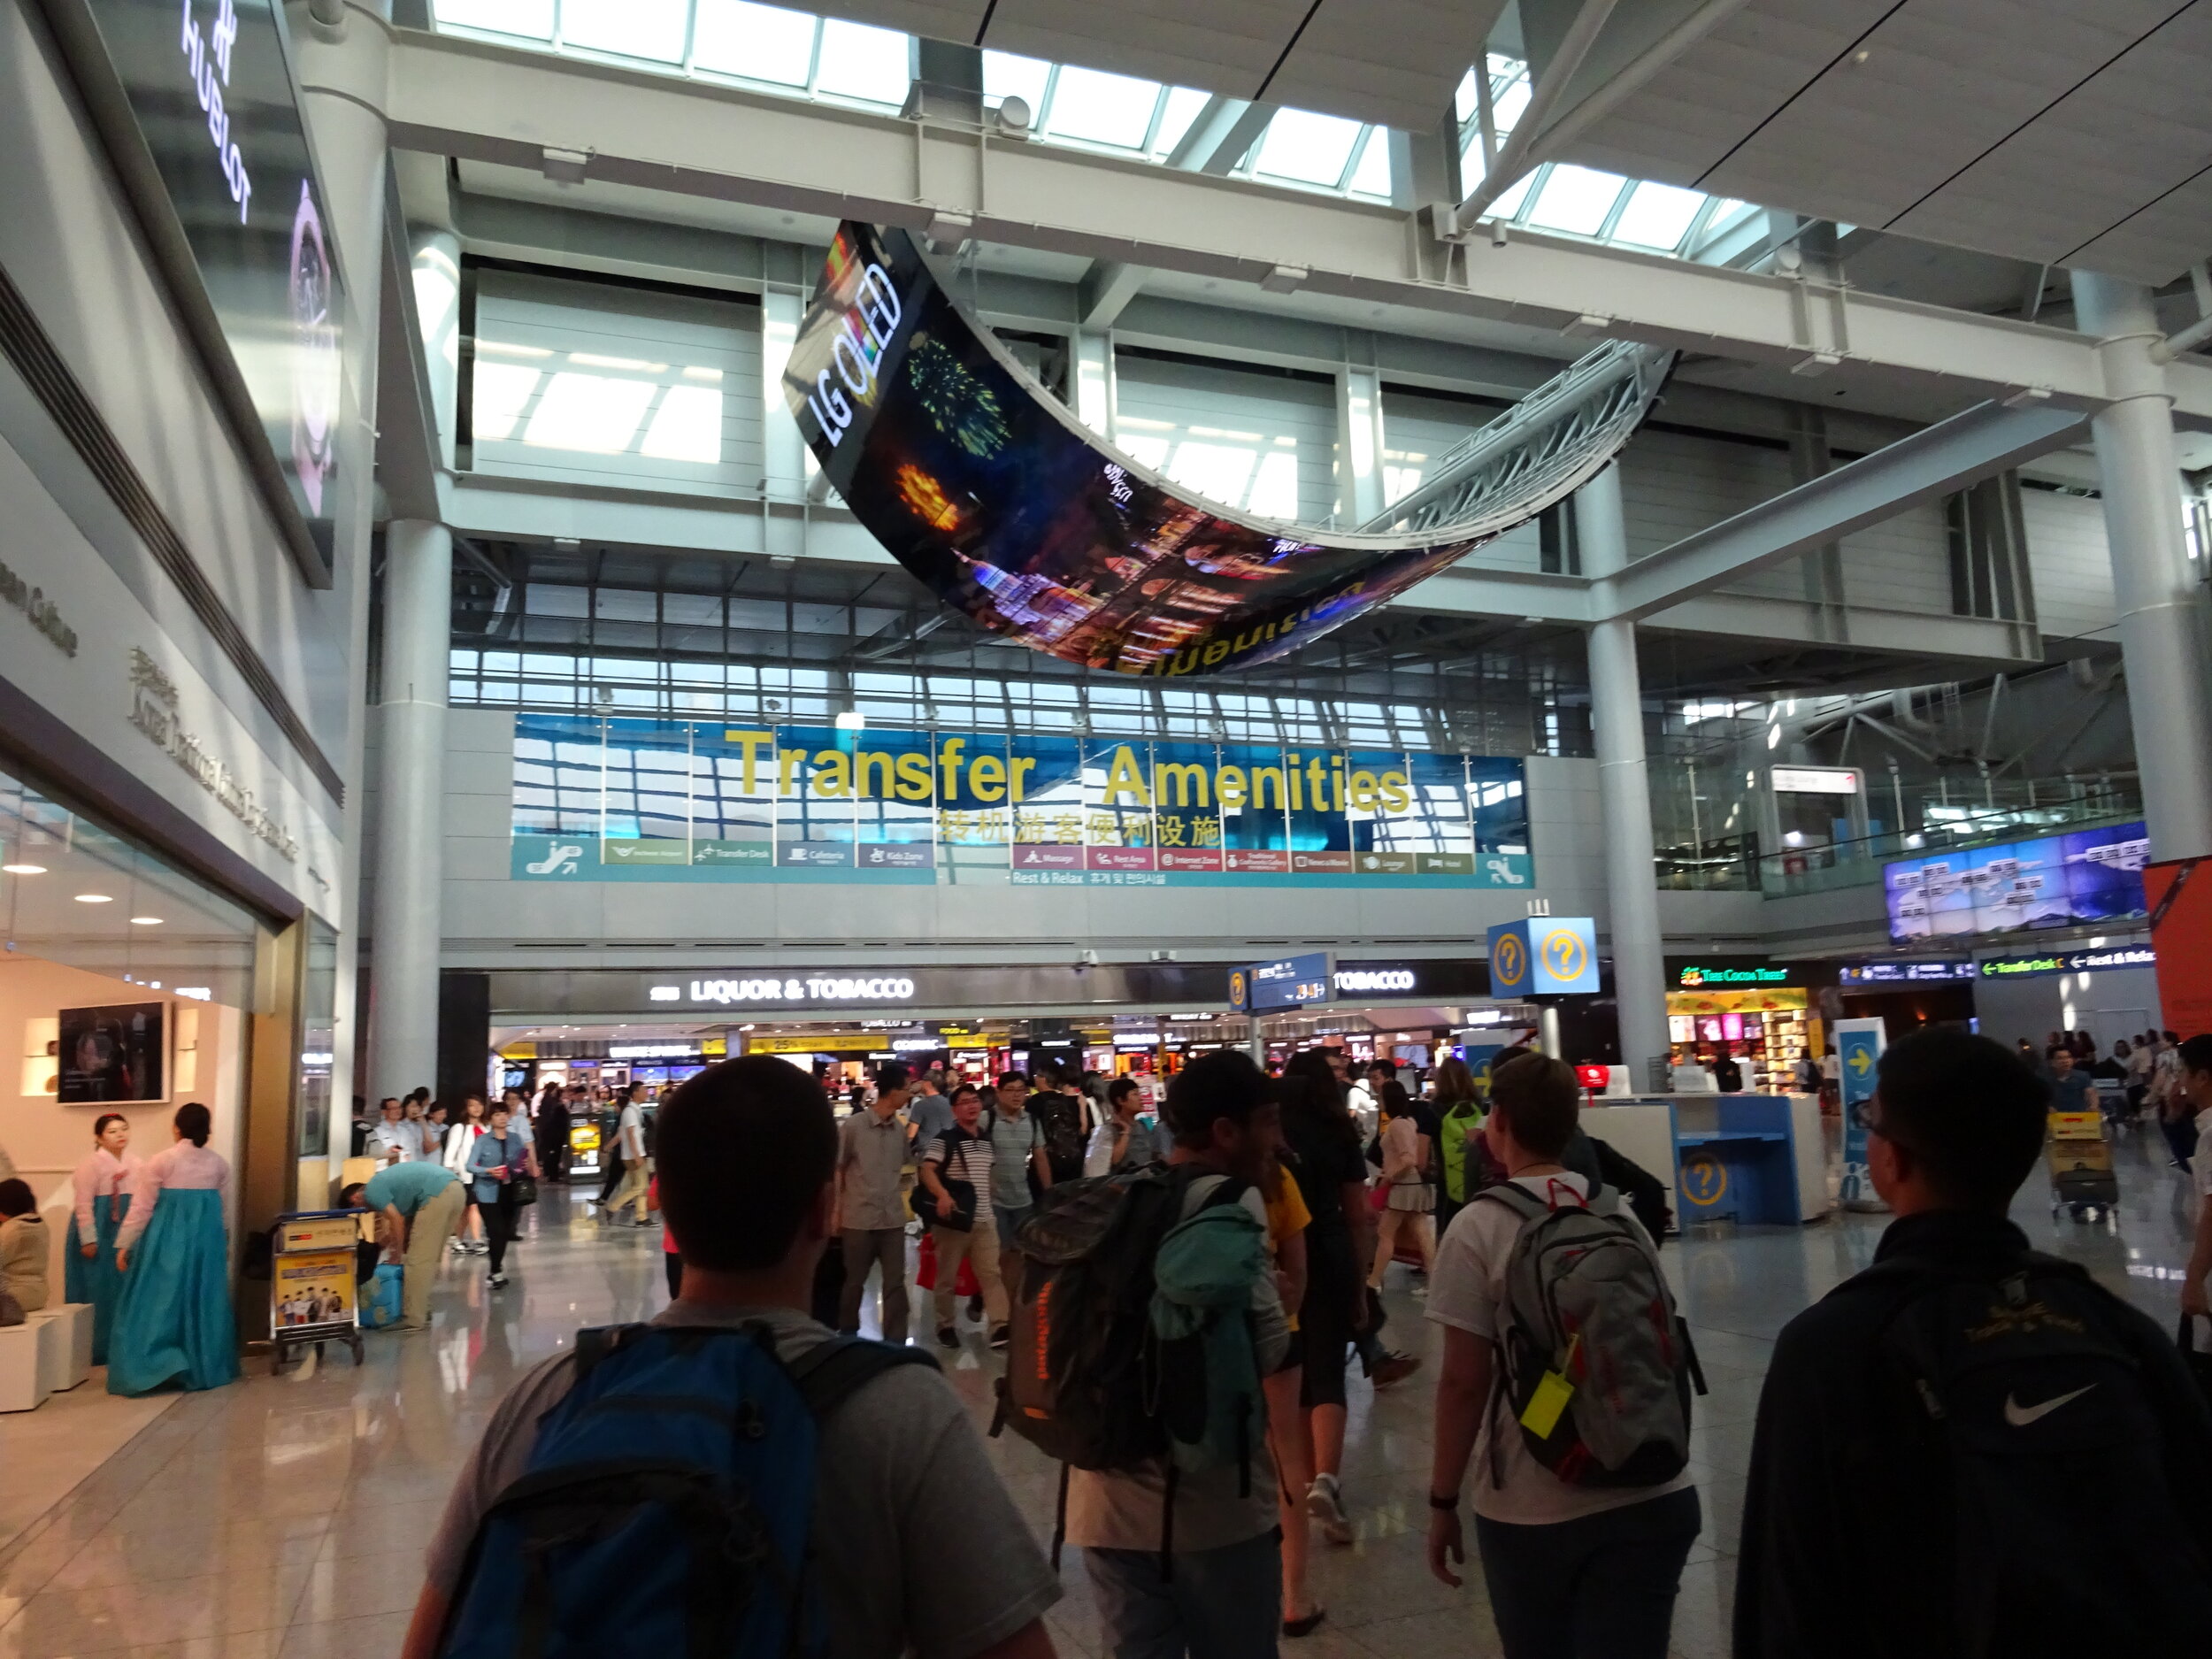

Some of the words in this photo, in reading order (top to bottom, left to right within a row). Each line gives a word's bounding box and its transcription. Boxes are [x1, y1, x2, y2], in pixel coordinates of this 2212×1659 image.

[182, 0, 252, 226] HUBLOT
[808, 369, 853, 448] LG
[833, 263, 902, 396] OLED
[725, 731, 1036, 803] Transfer
[1102, 745, 1410, 813] Amenities
[939, 809, 1221, 848] 转机游客便利设施
[717, 849, 749, 858] Transfer
[749, 849, 770, 858] Desk
[1012, 872, 1039, 884] Rest
[1040, 872, 1050, 884] &
[1051, 872, 1084, 885] Relax
[690, 979, 783, 1004] LIQUOR
[784, 979, 804, 1000] &
[806, 978, 915, 999] TOBACCO
[1333, 971, 1415, 990] TOBACCO
